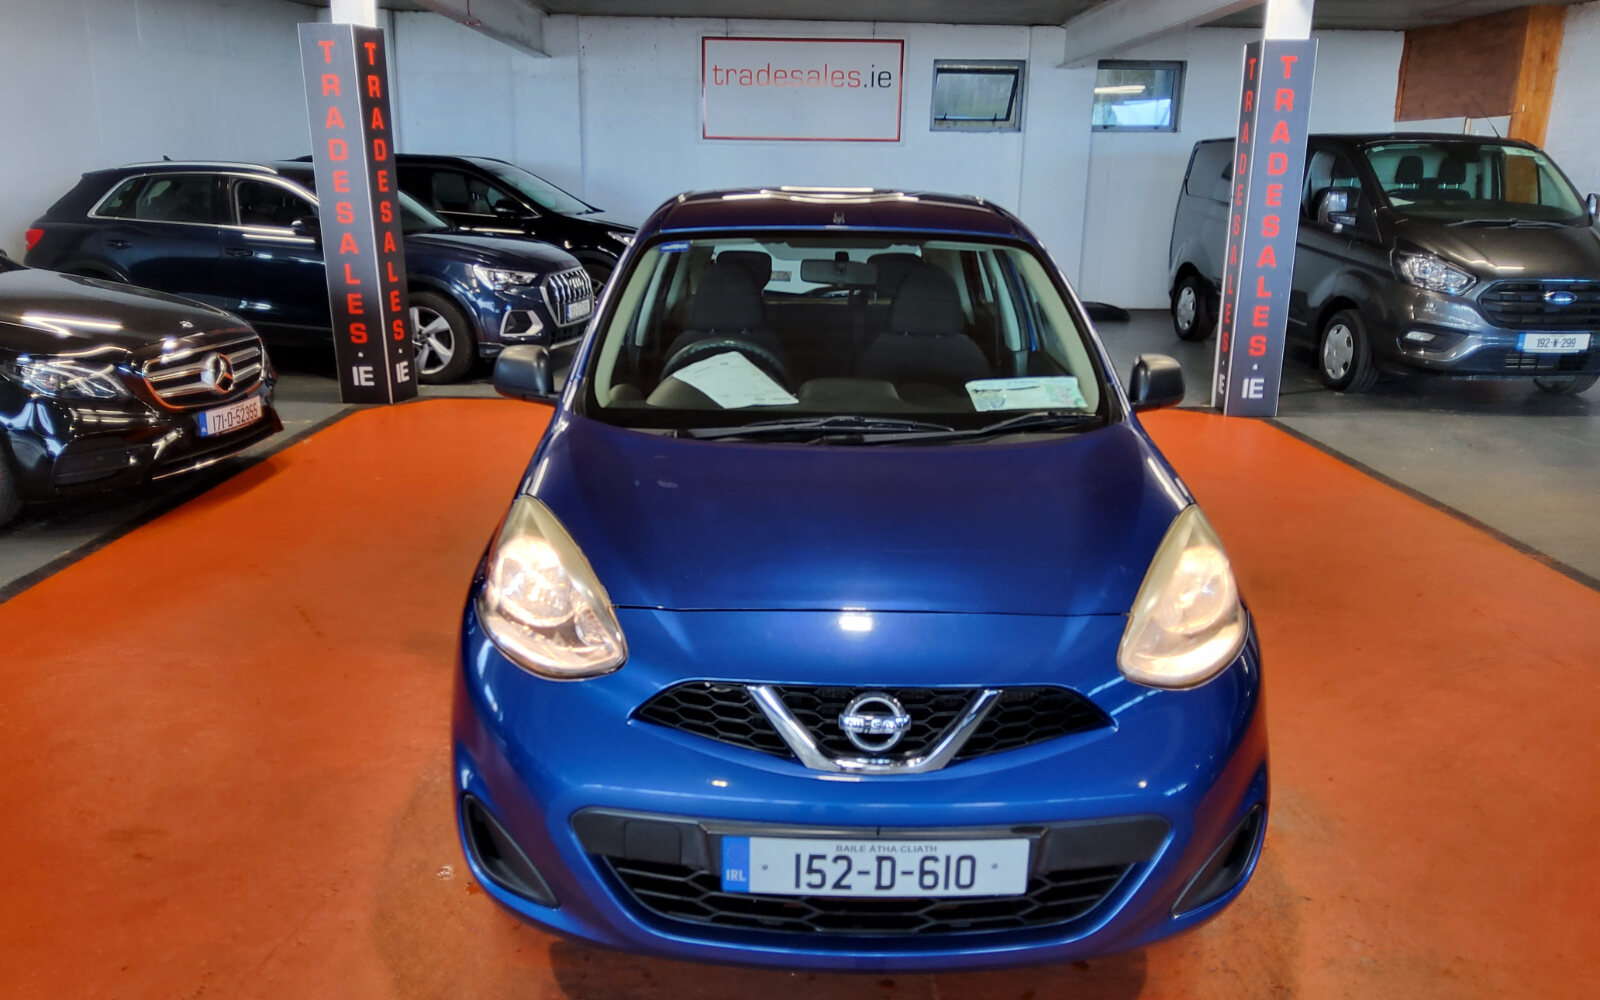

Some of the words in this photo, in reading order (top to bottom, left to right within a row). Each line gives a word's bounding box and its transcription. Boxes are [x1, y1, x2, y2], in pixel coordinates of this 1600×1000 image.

[712, 62, 892, 88] tradesales.ie
[835, 844, 866, 853] BAILE
[899, 844, 938, 854] CLIATH
[725, 869, 747, 882] IRL
[794, 853, 977, 891] 152-D-610
